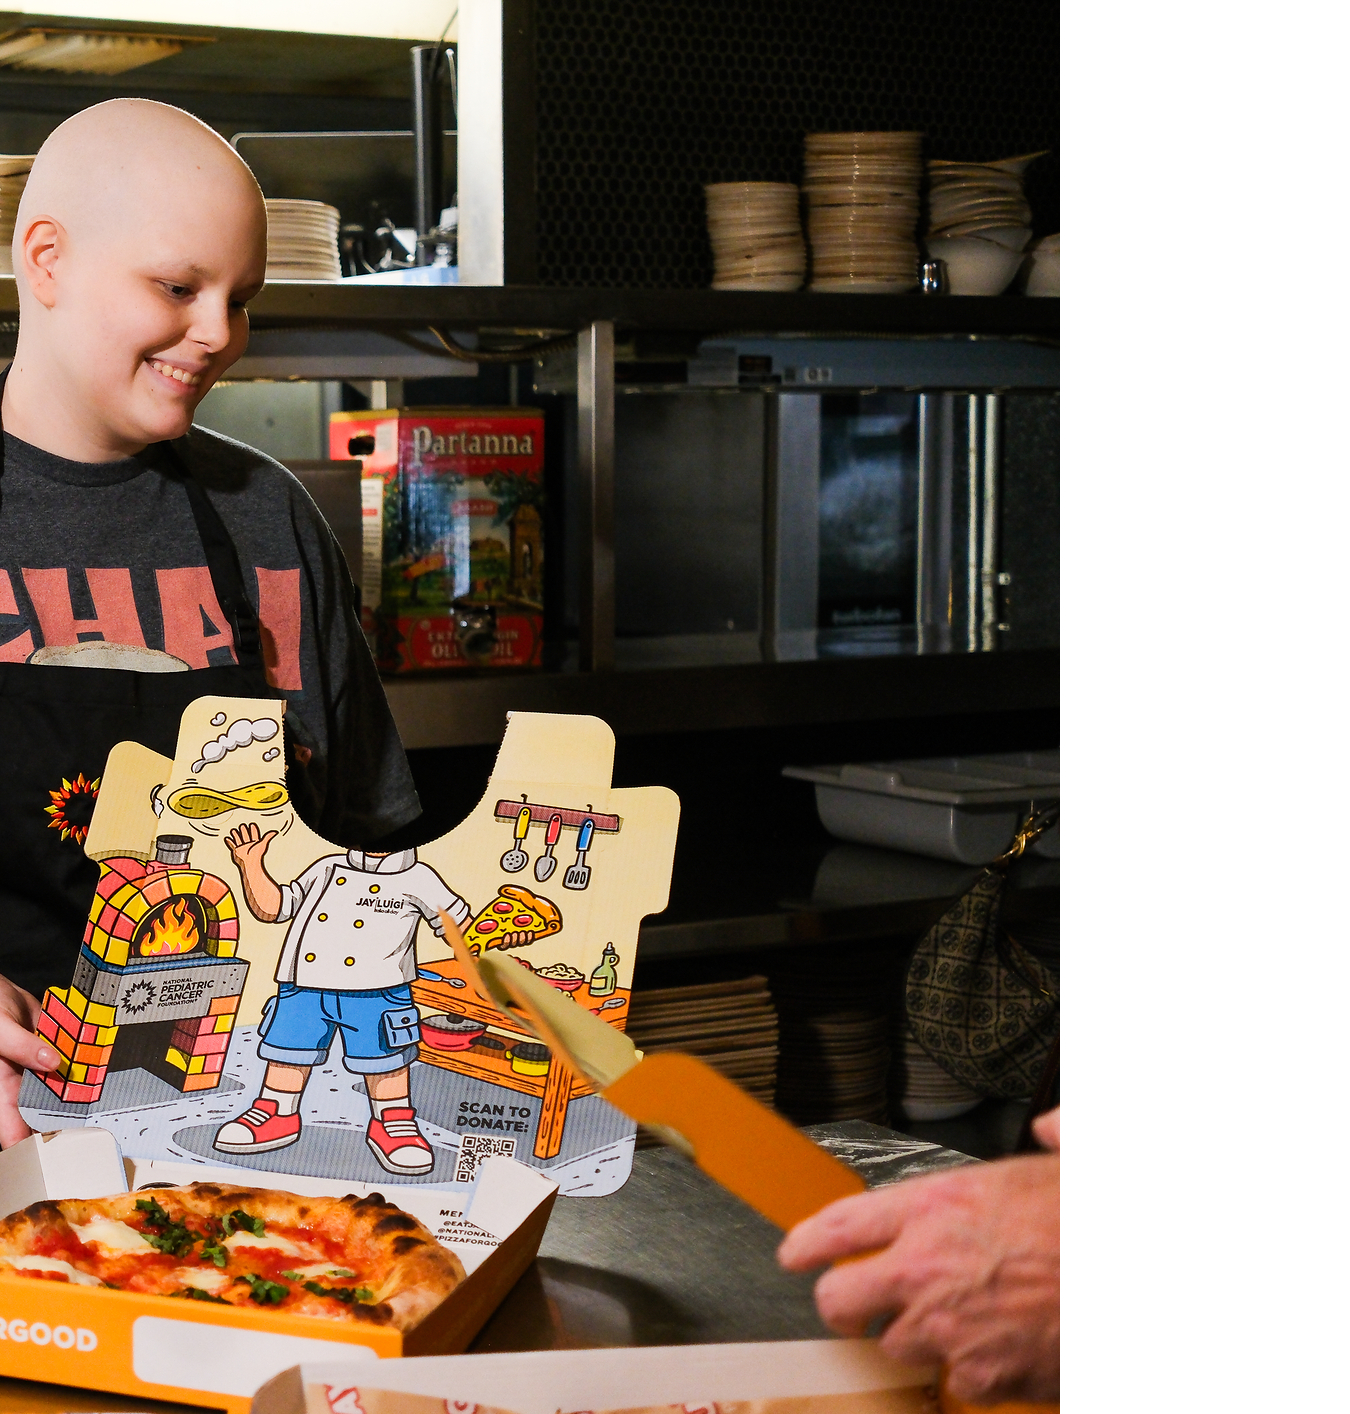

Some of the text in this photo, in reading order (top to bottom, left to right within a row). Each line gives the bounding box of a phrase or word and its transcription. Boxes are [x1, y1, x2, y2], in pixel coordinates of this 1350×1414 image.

[412, 425, 534, 469] Partanna
[160, 979, 215, 994] PEDIATRIC
[162, 977, 193, 985] NATIONAL
[158, 989, 204, 1002] CANCER
[458, 1101, 531, 1119] SCAN TO
[456, 1115, 529, 1133] DONATE:
